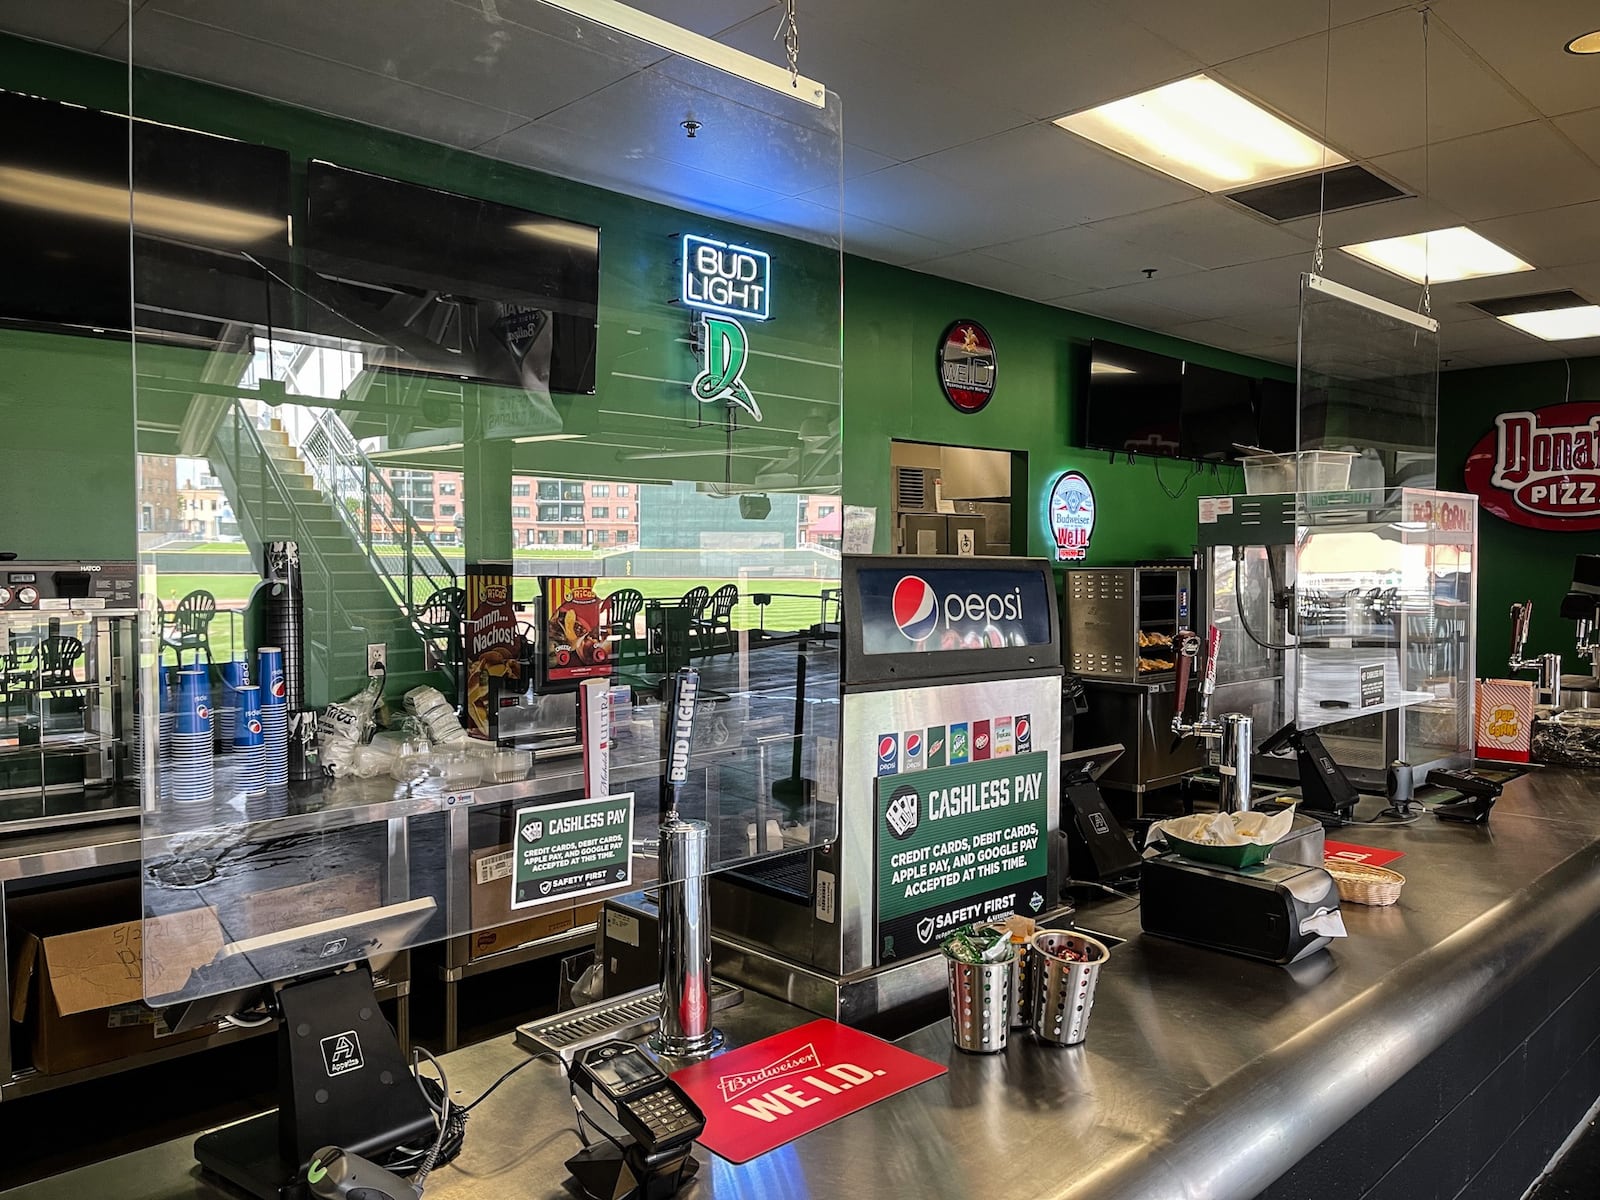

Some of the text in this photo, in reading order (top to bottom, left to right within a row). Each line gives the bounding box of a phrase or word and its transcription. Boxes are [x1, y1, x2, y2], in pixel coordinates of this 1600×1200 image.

[697, 246, 758, 281] BUD
[687, 273, 764, 310] LIGHT
[1531, 482, 1600, 505] PIZZ
[1056, 513, 1090, 525] Budweiser
[1058, 528, 1073, 545] We
[473, 609, 509, 634] mmm...
[944, 587, 1023, 629] pepsi
[473, 625, 515, 655] Nachos!
[1495, 709, 1515, 722] POP
[671, 680, 697, 781] BUD LIGHT
[1488, 722, 1518, 738] CORN!
[880, 762, 896, 771] pepsi
[928, 772, 1042, 821] CASHLESS PAY
[549, 808, 627, 835] CASHLESS PAY
[524, 834, 624, 858] CREDIT CARDS, DEBIT CARDS,
[524, 842, 623, 866] APPLE PAY, AND GOOGLE PAY
[891, 822, 1039, 868] CREDIT CARDS, DEBIT CARDS,
[532, 850, 616, 873] ACCEPTED AT THIS TIME.
[892, 837, 1039, 885] APPLE PAY, AND GOOGLE PAY
[552, 870, 608, 888] SAFETY FIRST
[904, 855, 1028, 899] ACCEPTED AT THIS TIME.
[935, 893, 1016, 929] SAFETY FIRST
[717, 1051, 816, 1093] Budweiser
[731, 1063, 888, 1123] WE I.D.
